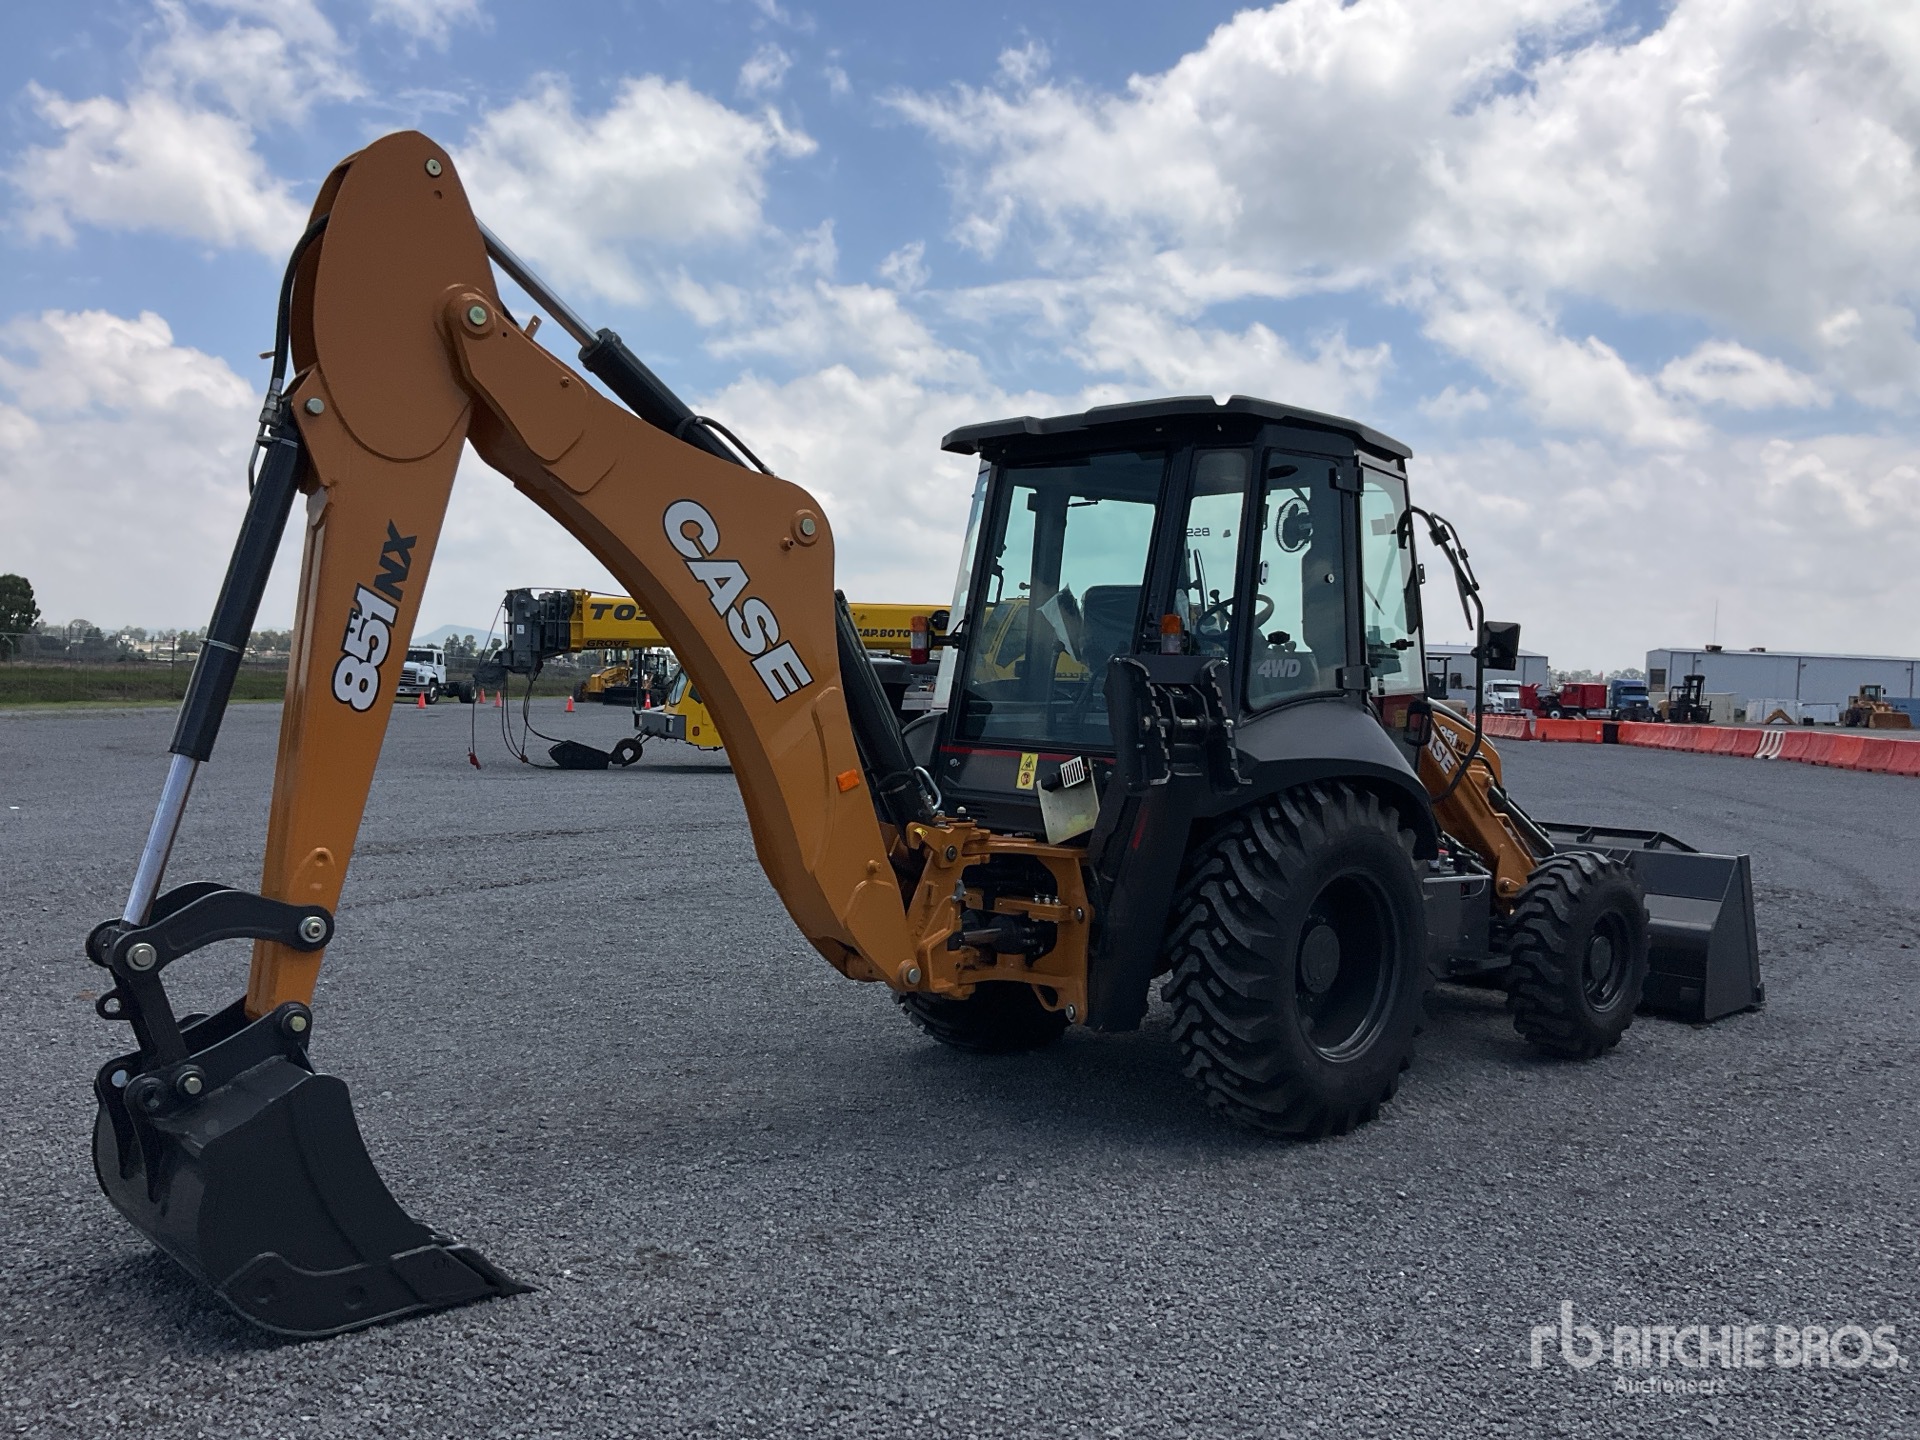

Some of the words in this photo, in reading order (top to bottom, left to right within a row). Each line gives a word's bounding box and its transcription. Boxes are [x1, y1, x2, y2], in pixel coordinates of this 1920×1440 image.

[662, 498, 814, 704] CASE
[586, 640, 630, 648] GROVE
[1257, 658, 1301, 678] 4WD
